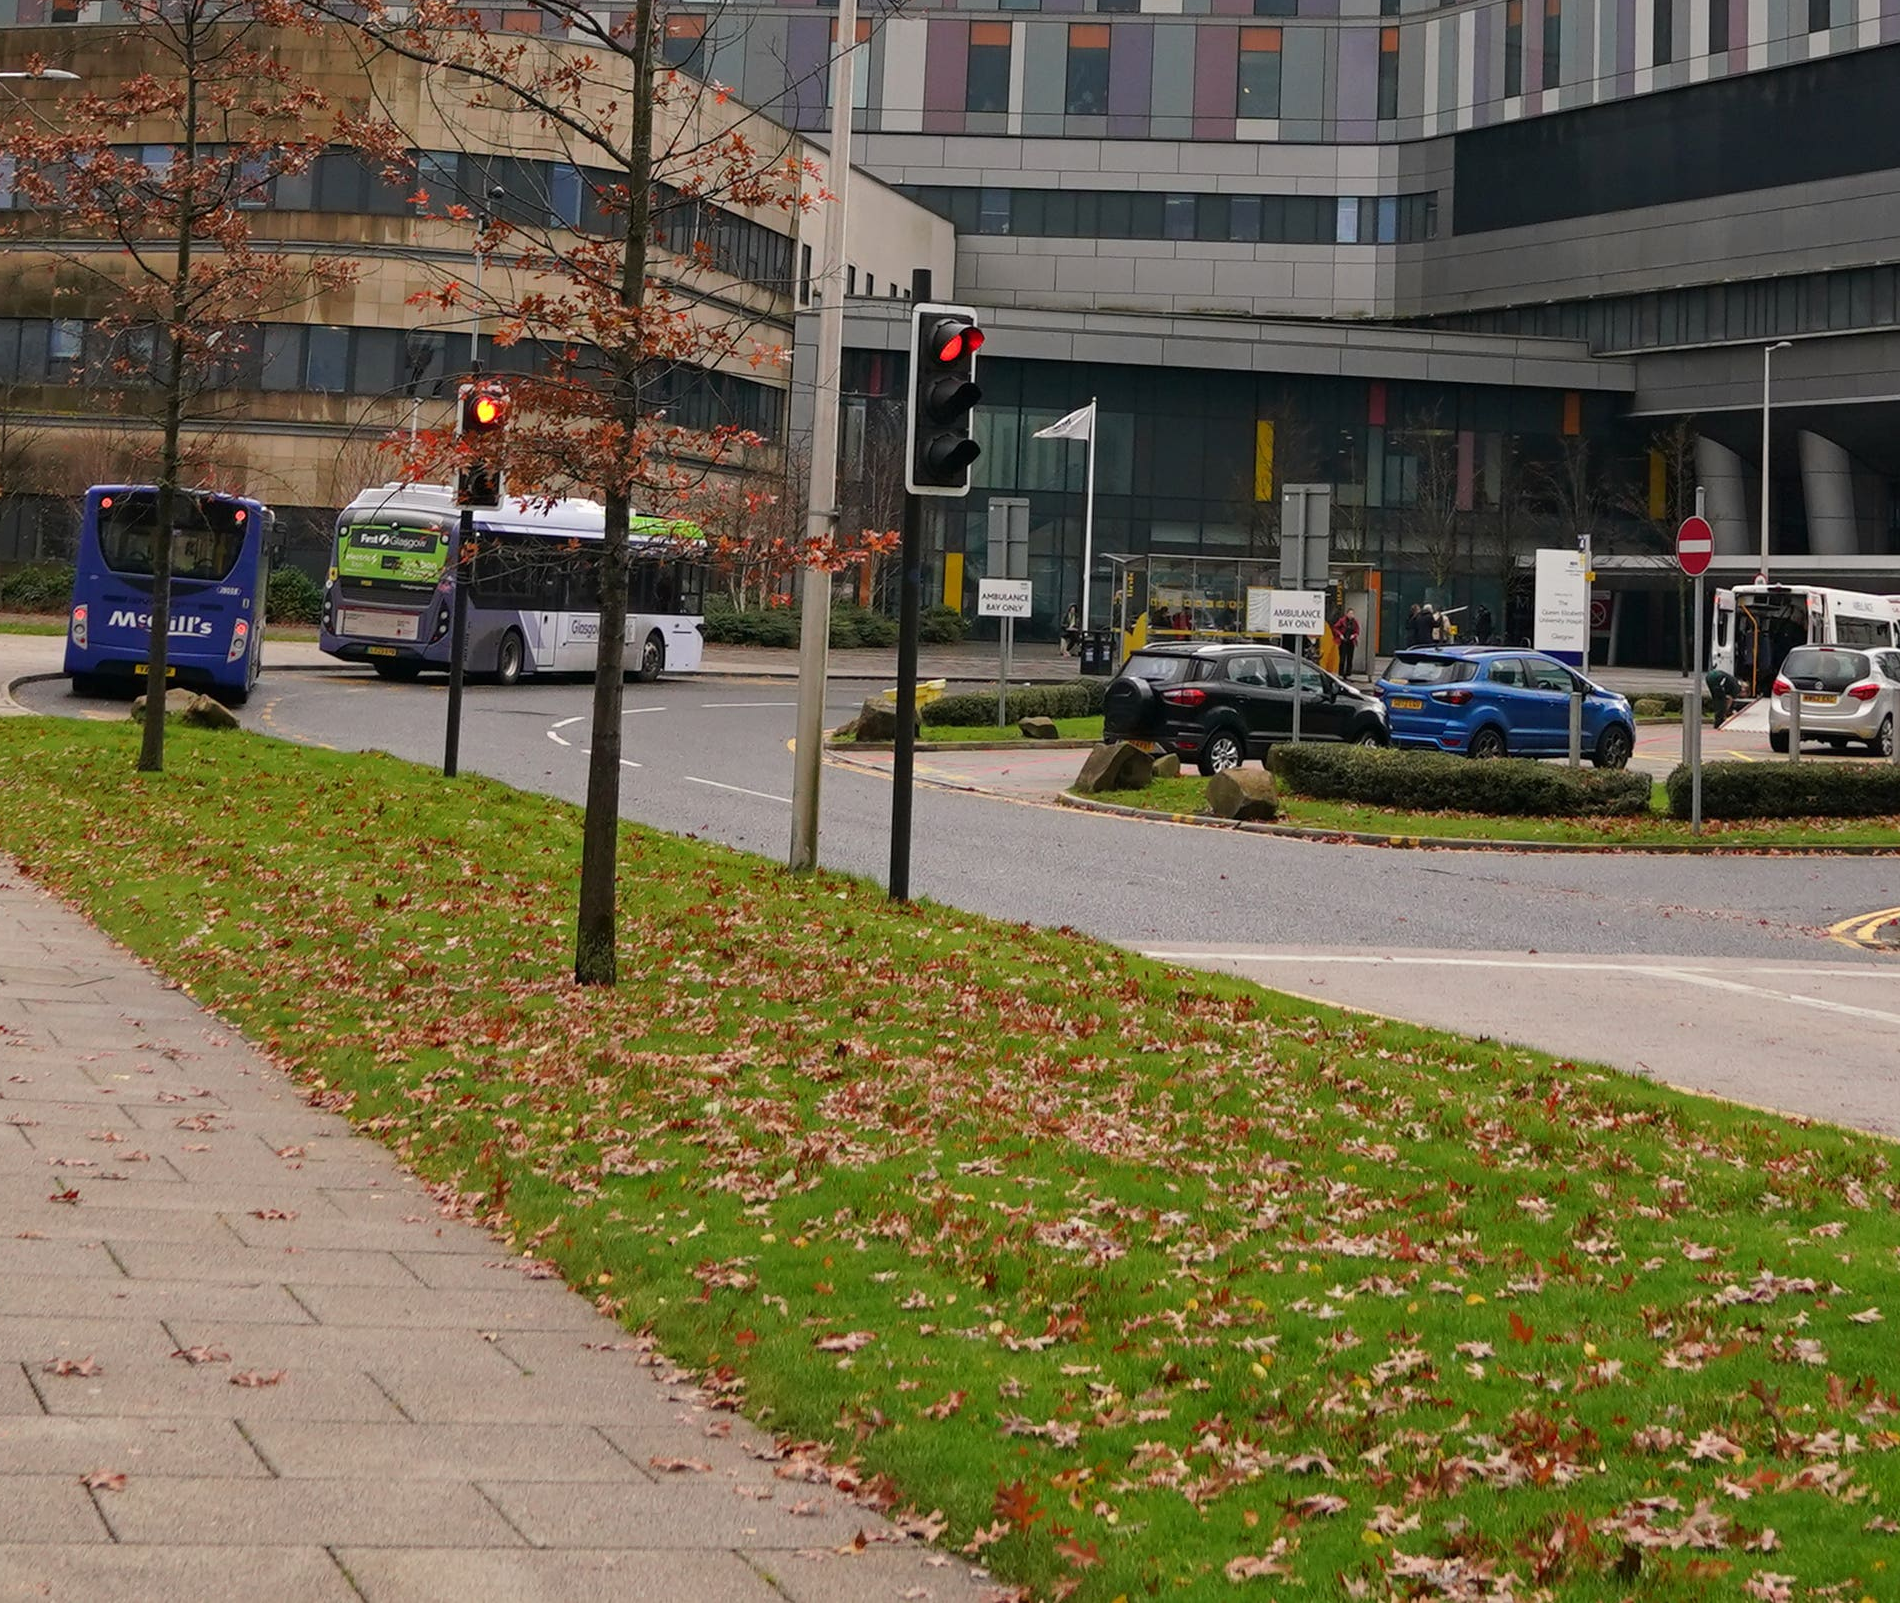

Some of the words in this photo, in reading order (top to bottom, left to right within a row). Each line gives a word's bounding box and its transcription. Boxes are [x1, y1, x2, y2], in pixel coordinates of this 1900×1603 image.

[360, 533, 379, 544] First
[389, 535, 428, 550] Glasgow
[981, 593, 1029, 602] AMBULANCE
[986, 603, 1001, 611] BAY
[1002, 604, 1024, 613] ONLY
[1273, 608, 1321, 619] AMBULANCE
[109, 610, 213, 635] Mcill's
[1278, 619, 1294, 628] BAY
[1295, 619, 1317, 629] ONLY
[571, 619, 599, 638] Glasgo
